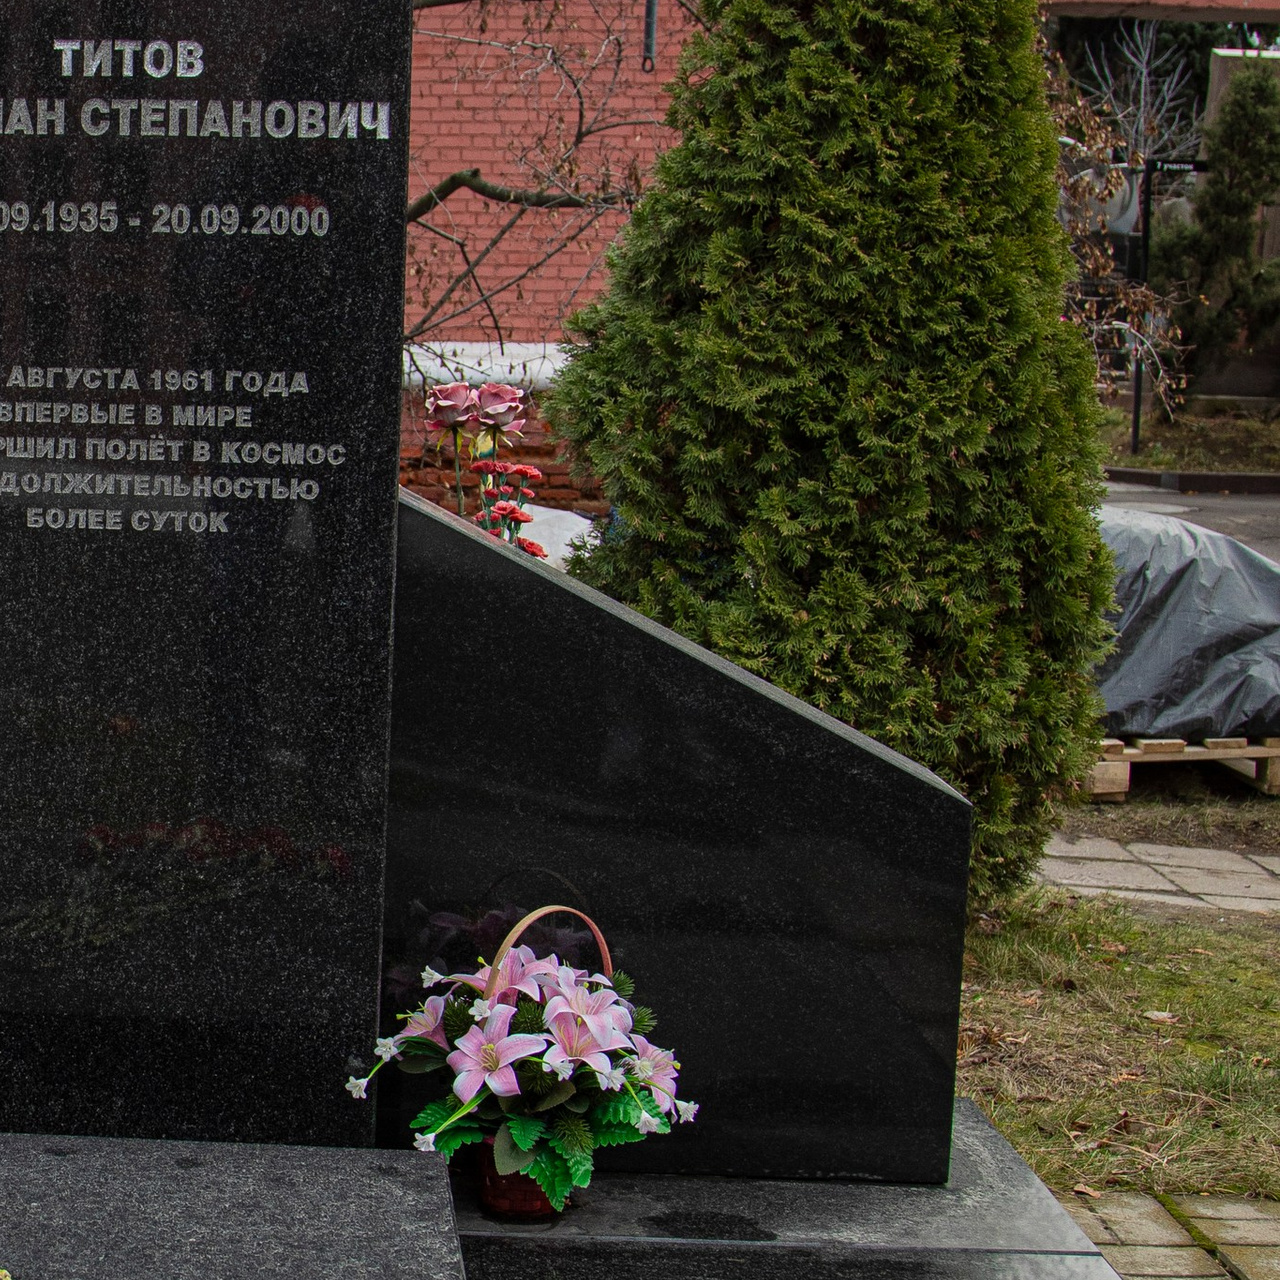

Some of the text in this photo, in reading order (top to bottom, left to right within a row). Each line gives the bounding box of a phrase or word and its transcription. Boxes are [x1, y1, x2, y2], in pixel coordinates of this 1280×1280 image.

[54, 39, 205, 78] ТИТОВ
[81, 98, 390, 140] СТЕПАНОВИЧ
[152, 203, 330, 237] 20.09.2000
[6, 367, 140, 391] АВГУСТА
[151, 369, 213, 392] 1961
[225, 370, 310, 397] ГОДА
[146, 405, 162, 426] В
[172, 406, 252, 428] МИРЕ
[86, 435, 183, 462] ПОЛЁТ
[193, 439, 210, 462] В
[221, 441, 347, 466] КОСМОС
[27, 507, 229, 533] БОЛЕЕ СУТОК
